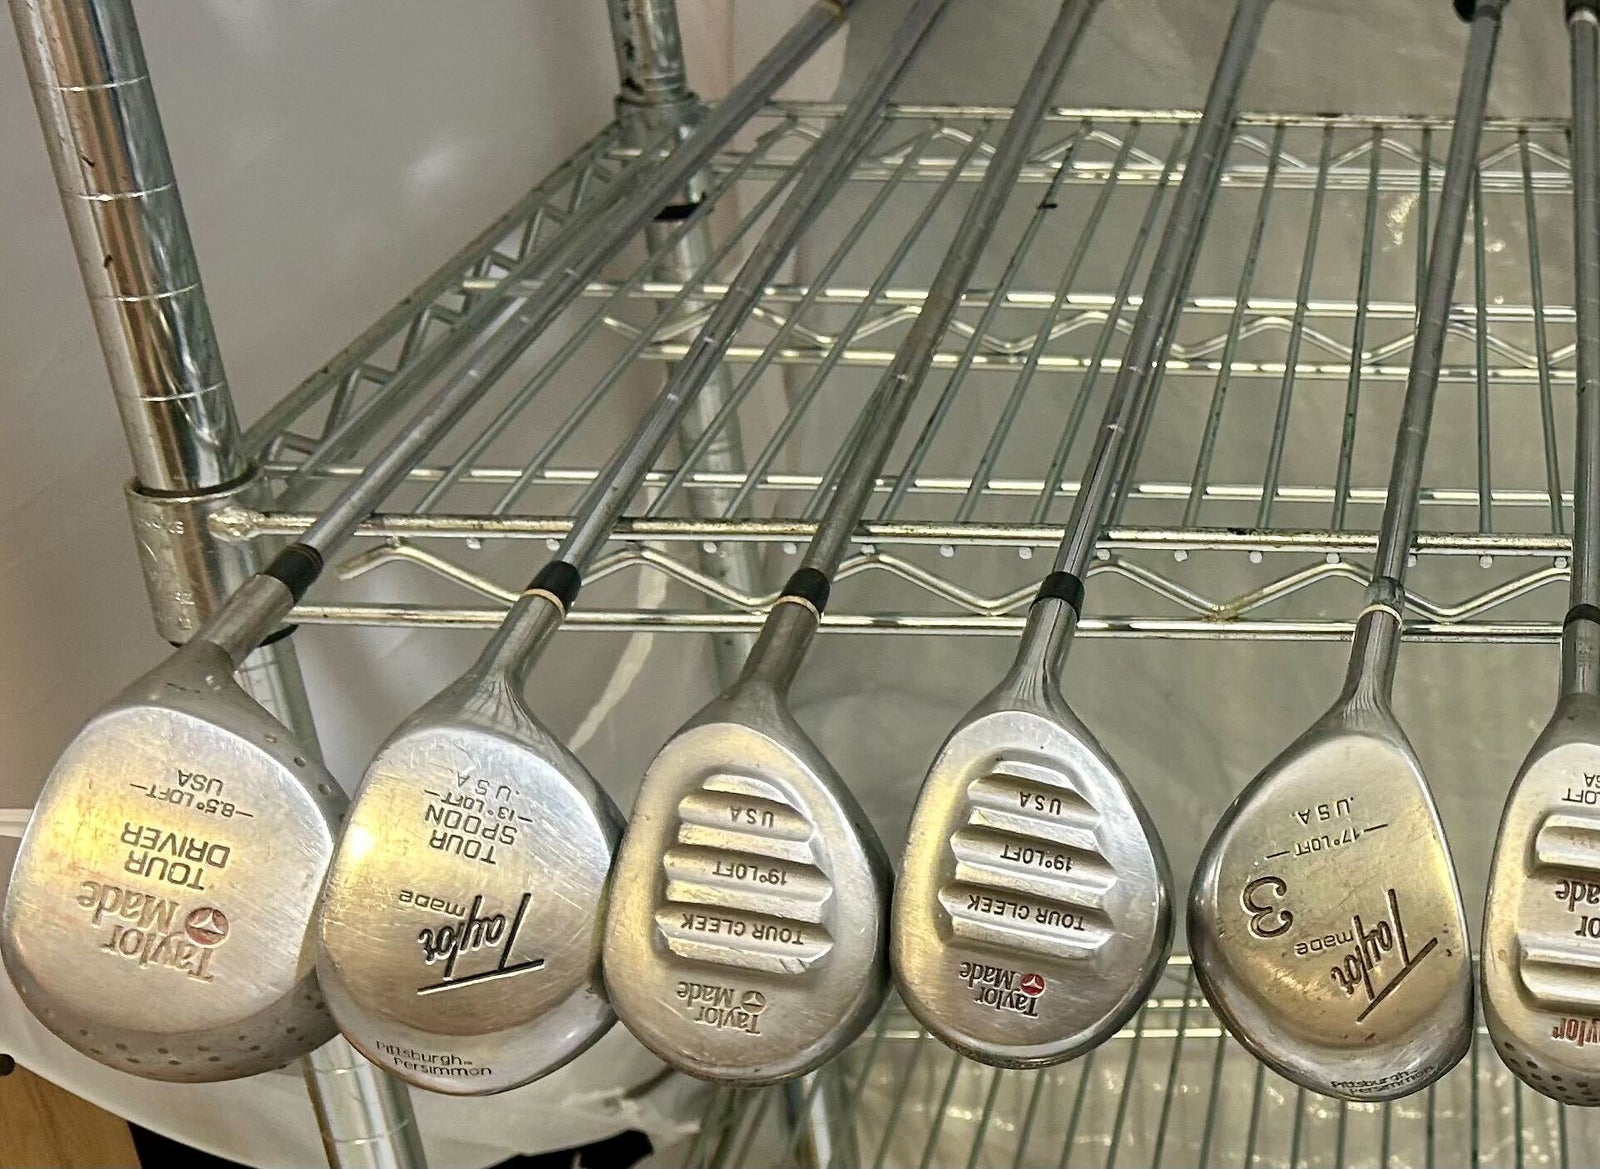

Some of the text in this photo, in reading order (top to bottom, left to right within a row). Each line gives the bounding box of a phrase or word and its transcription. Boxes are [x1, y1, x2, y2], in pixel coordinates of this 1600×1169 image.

[178, 769, 224, 793] USA
[145, 787, 192, 808] LOFT
[441, 790, 484, 813] LOFT
[1018, 791, 1062, 815] USA
[425, 804, 518, 846] SPOON
[729, 805, 774, 828] USA
[121, 821, 230, 869] DRIVER
[429, 829, 496, 865] TOUR
[1295, 836, 1331, 857] LOFT
[124, 851, 205, 890] TOUR
[77, 881, 180, 929] Made
[967, 894, 1086, 932] TOUR CLEEK
[1240, 875, 1294, 939] 3
[417, 892, 545, 996] Taylor
[680, 913, 804, 945] TOUR CLEEK
[102, 926, 215, 982] Taylor
[1330, 888, 1438, 1025] Taylor
[959, 961, 1017, 992] Made
[676, 980, 735, 1008] Made
[974, 985, 1039, 1018] Taylor
[694, 1004, 761, 1035] Taylor
[393, 1056, 492, 1077] Persimmon
